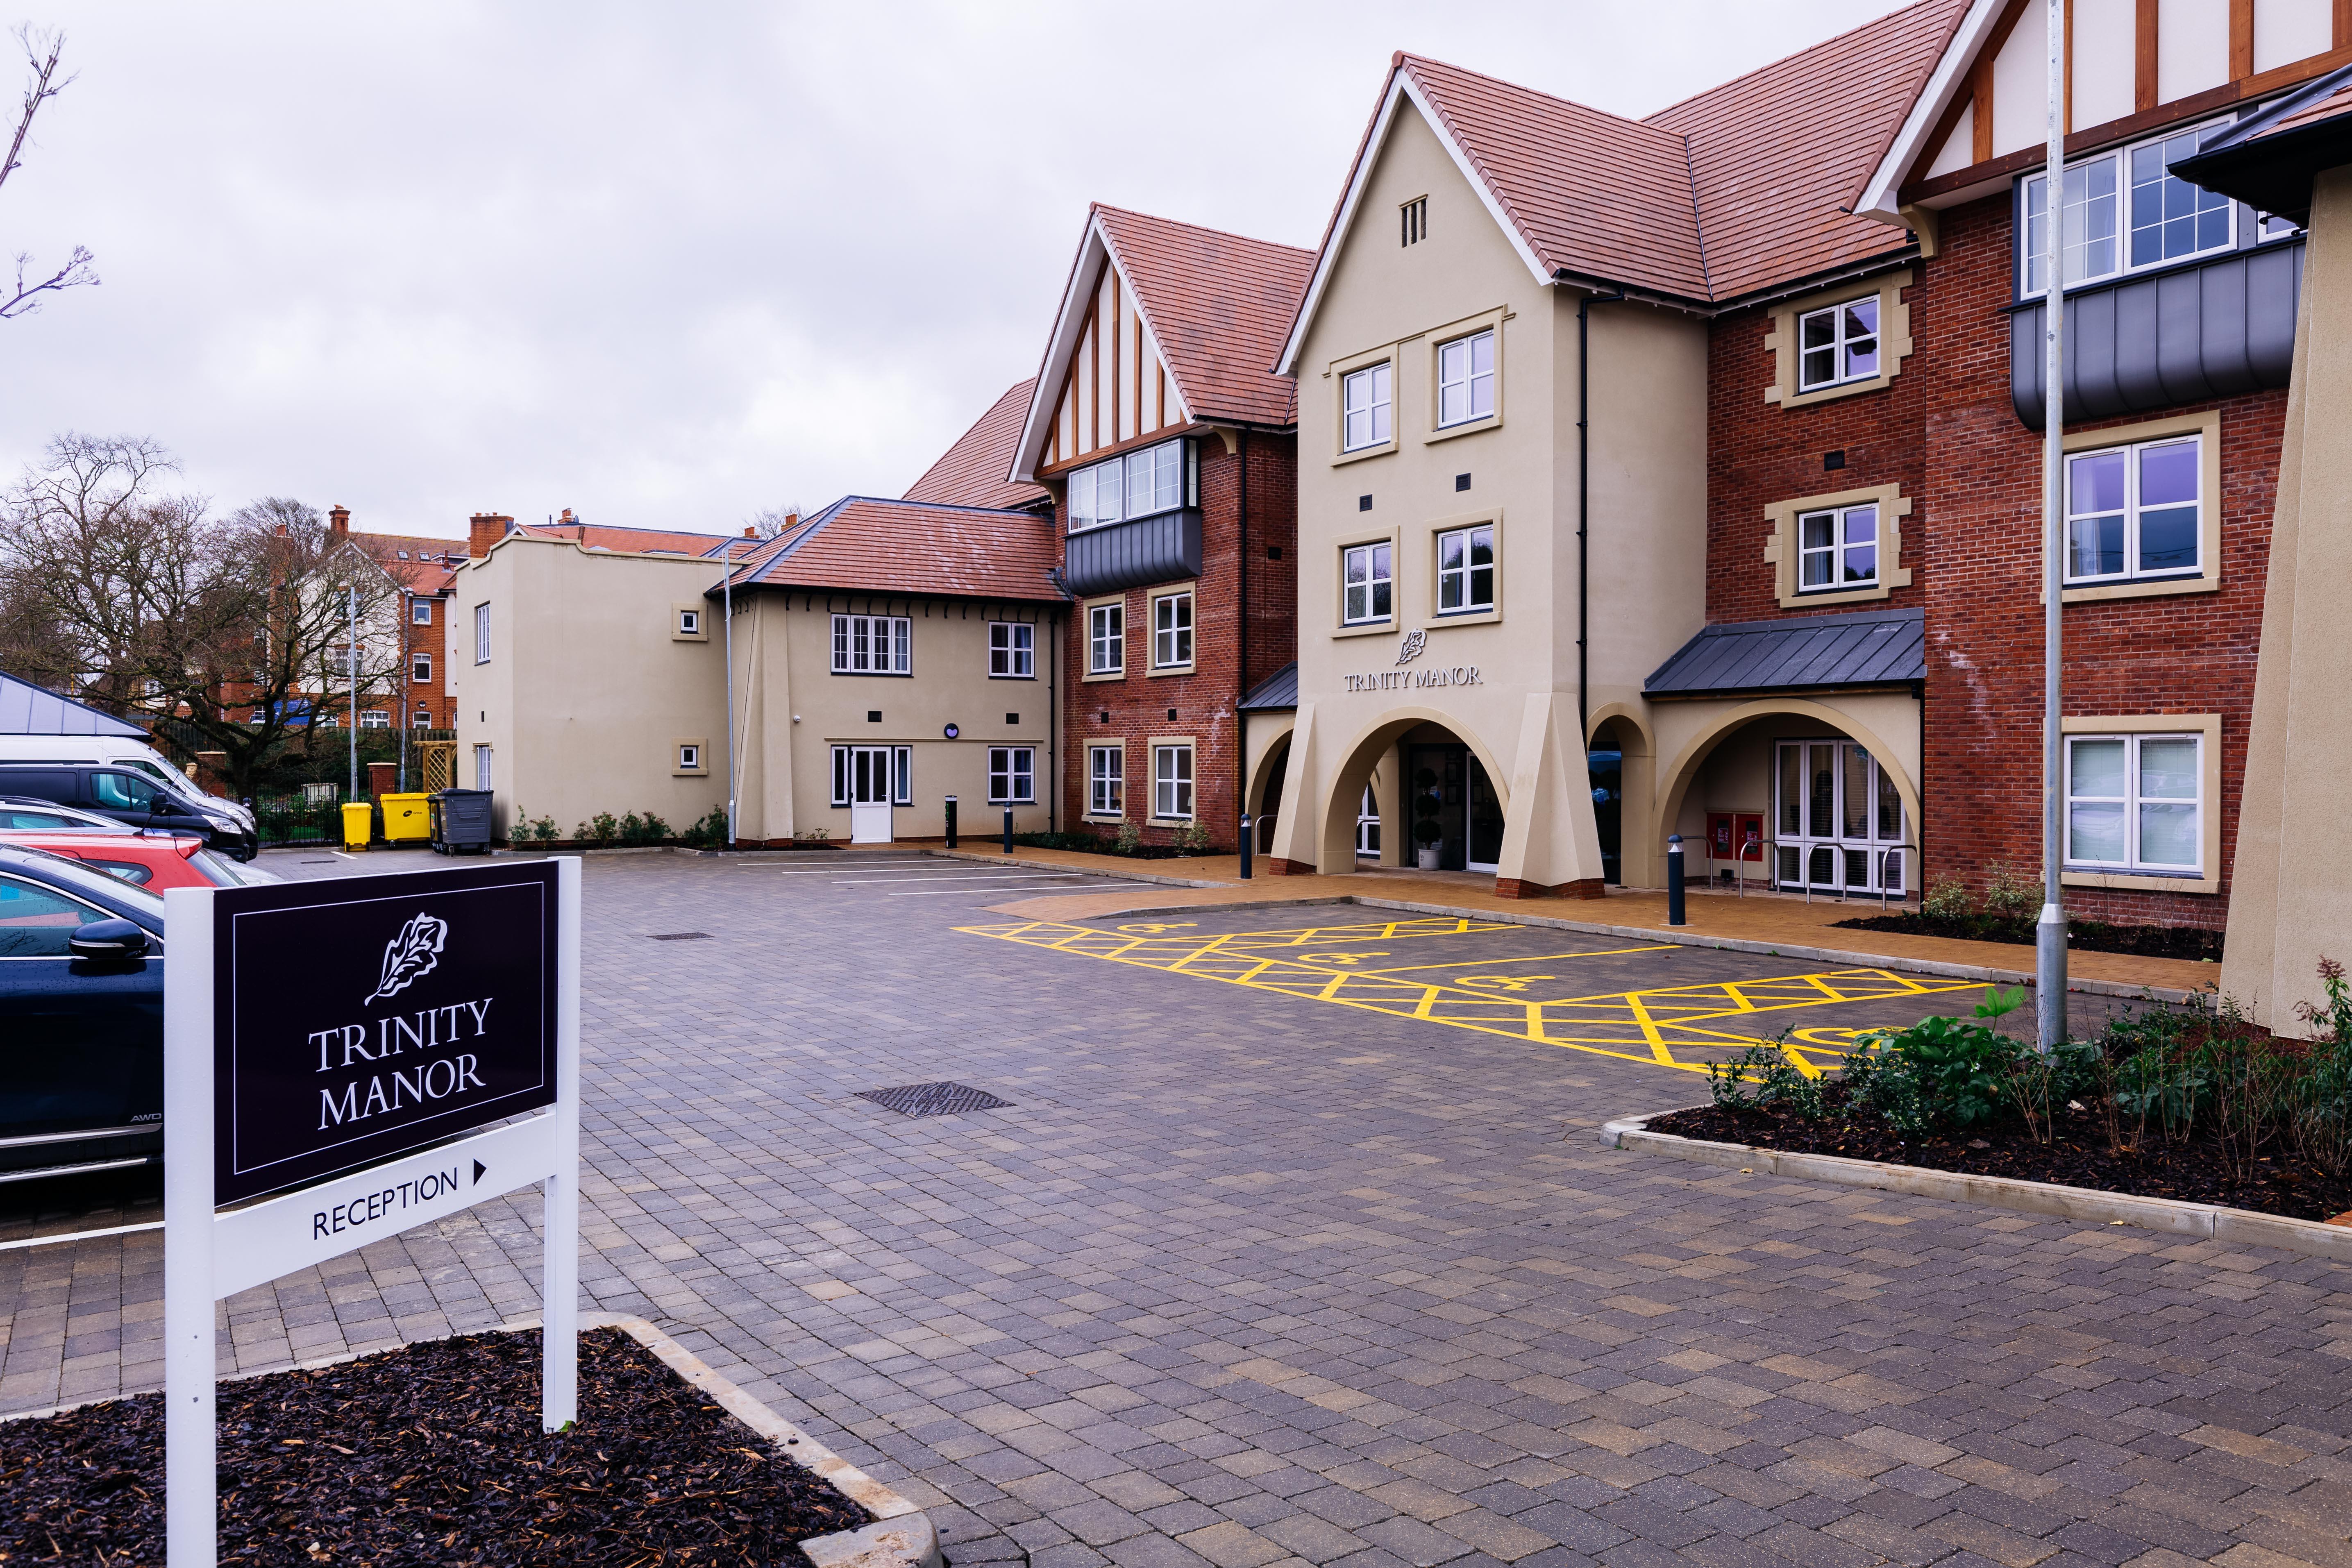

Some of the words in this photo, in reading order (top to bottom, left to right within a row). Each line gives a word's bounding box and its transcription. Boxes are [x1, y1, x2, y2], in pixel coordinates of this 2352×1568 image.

[1344, 670, 1411, 691] TRINITY
[1416, 665, 1483, 687] MANOR
[309, 998, 493, 1072] TRINITY
[130, 1113, 162, 1122] AWD
[318, 1054, 486, 1130] MANOR
[314, 1167, 457, 1240] RECEPTION
